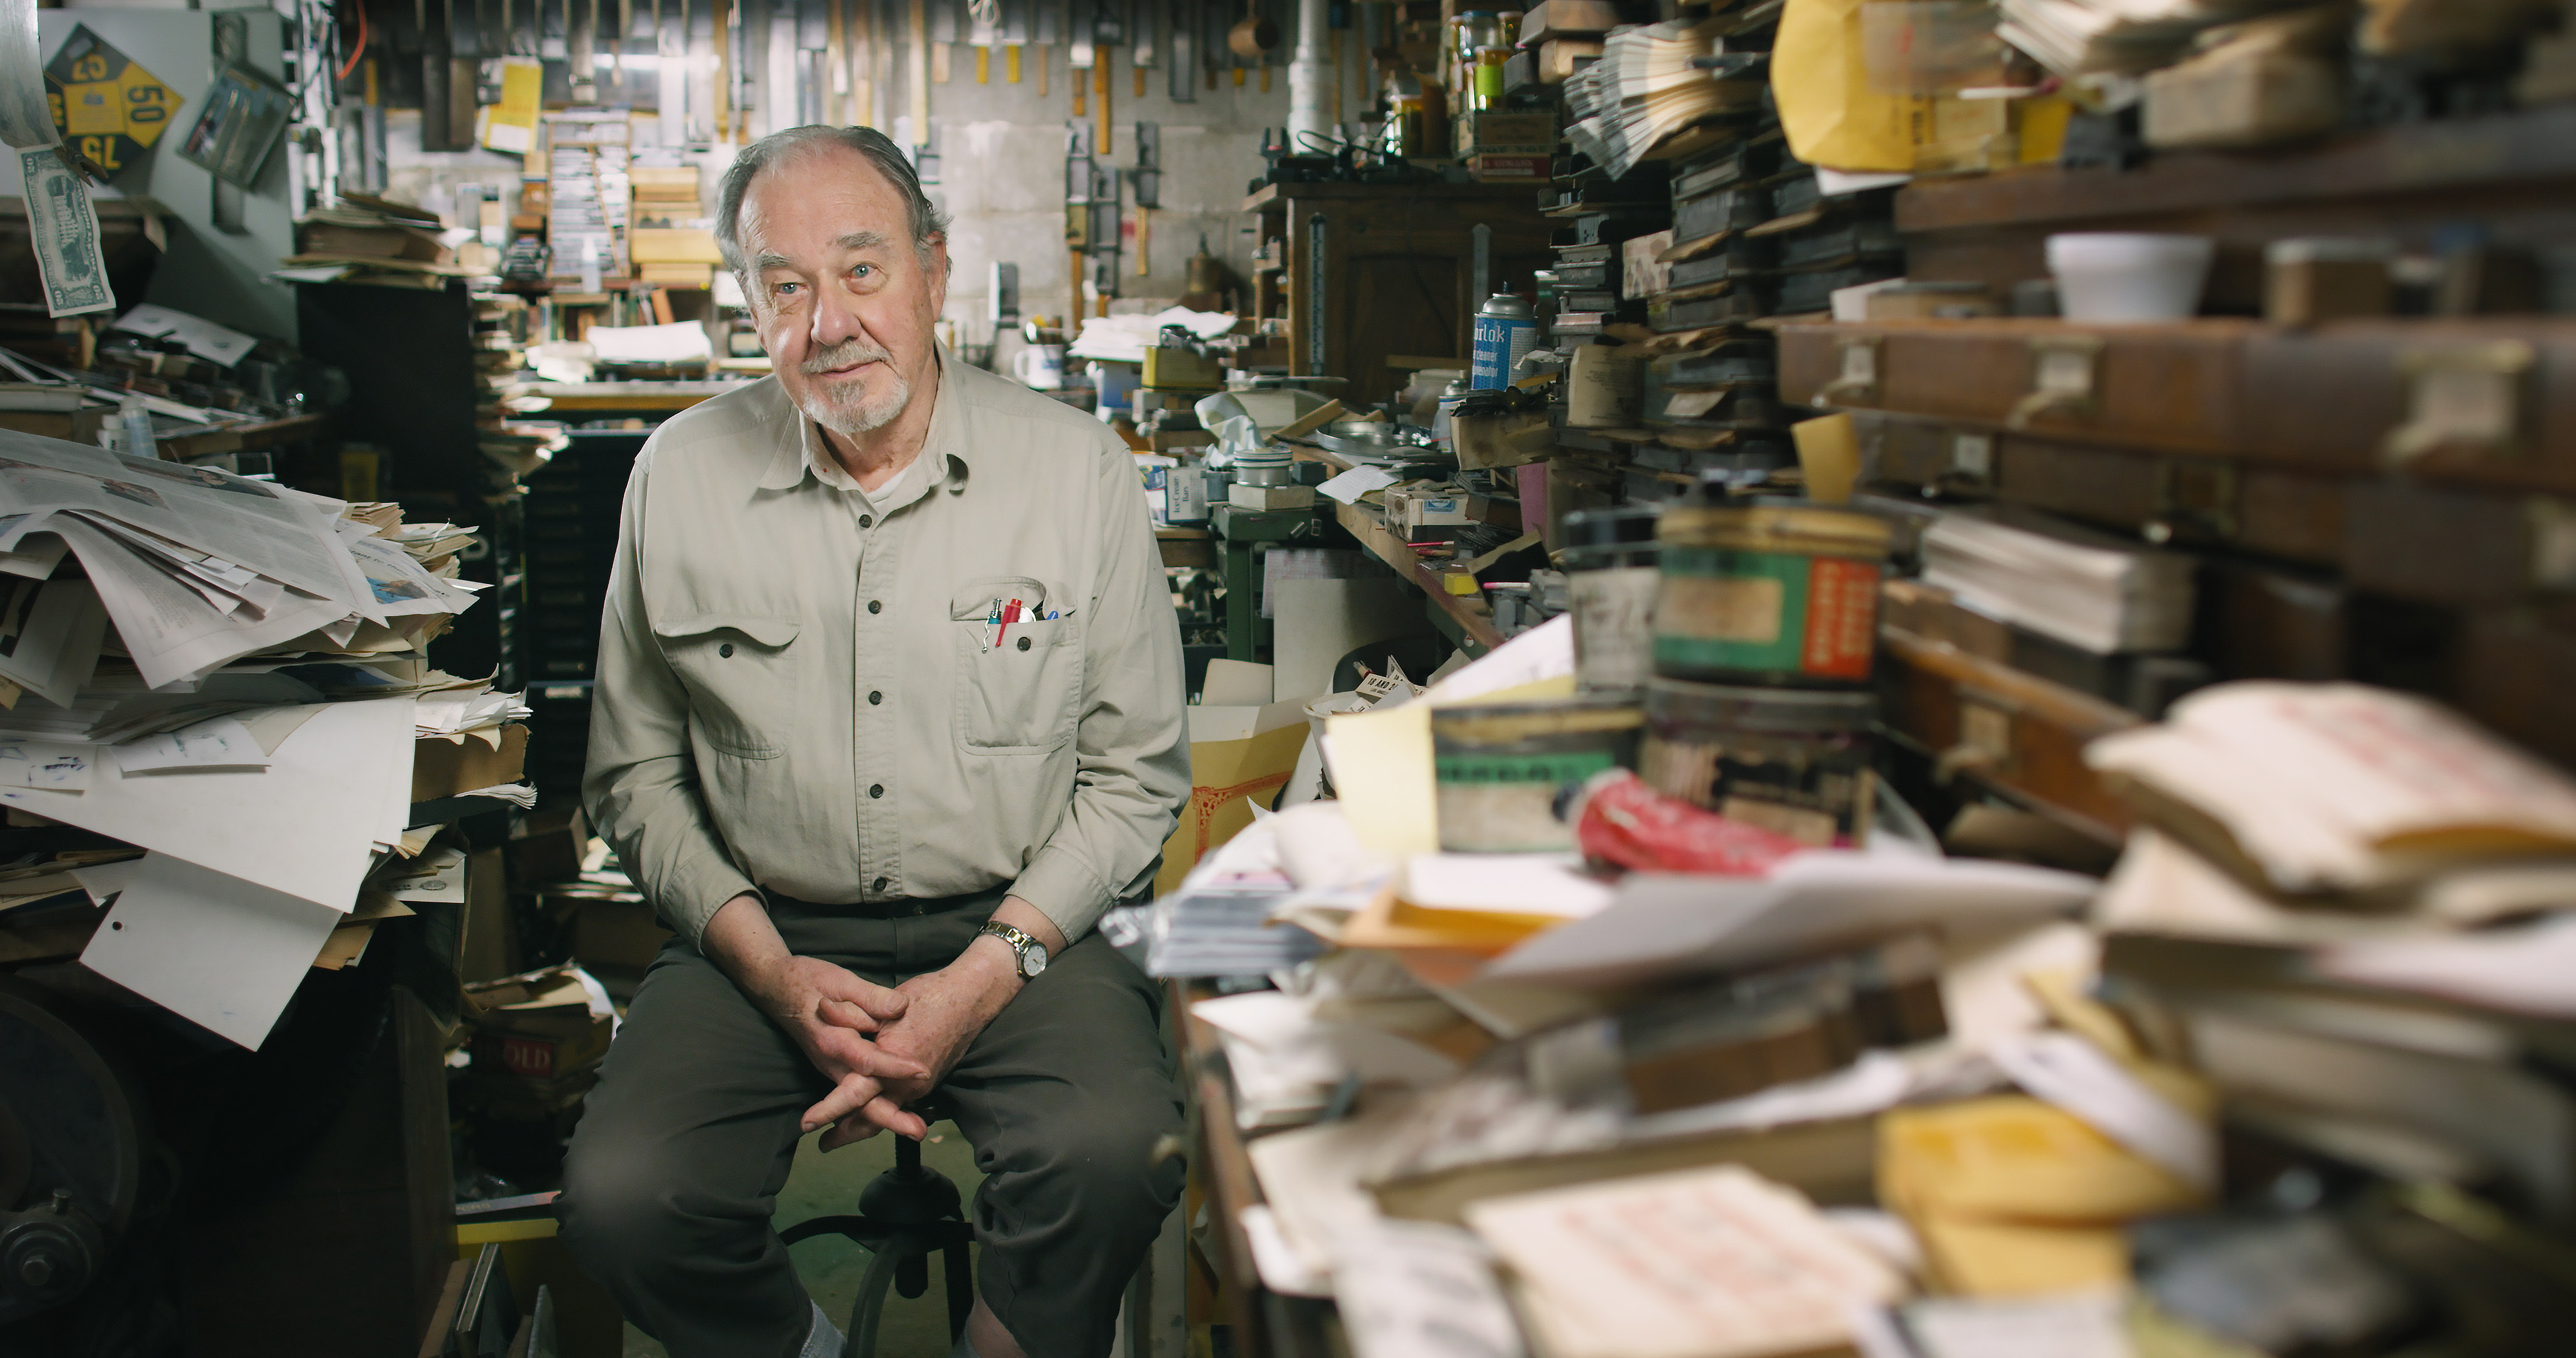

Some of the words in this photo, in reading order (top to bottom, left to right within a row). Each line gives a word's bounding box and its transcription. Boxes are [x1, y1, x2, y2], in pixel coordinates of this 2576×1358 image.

[128, 86, 166, 122] 50
[80, 136, 121, 169] 75
[26, 158, 35, 174] 20
[54, 290, 64, 306] 20
[92, 284, 103, 301] 20
[1375, 680, 1390, 689] AND
